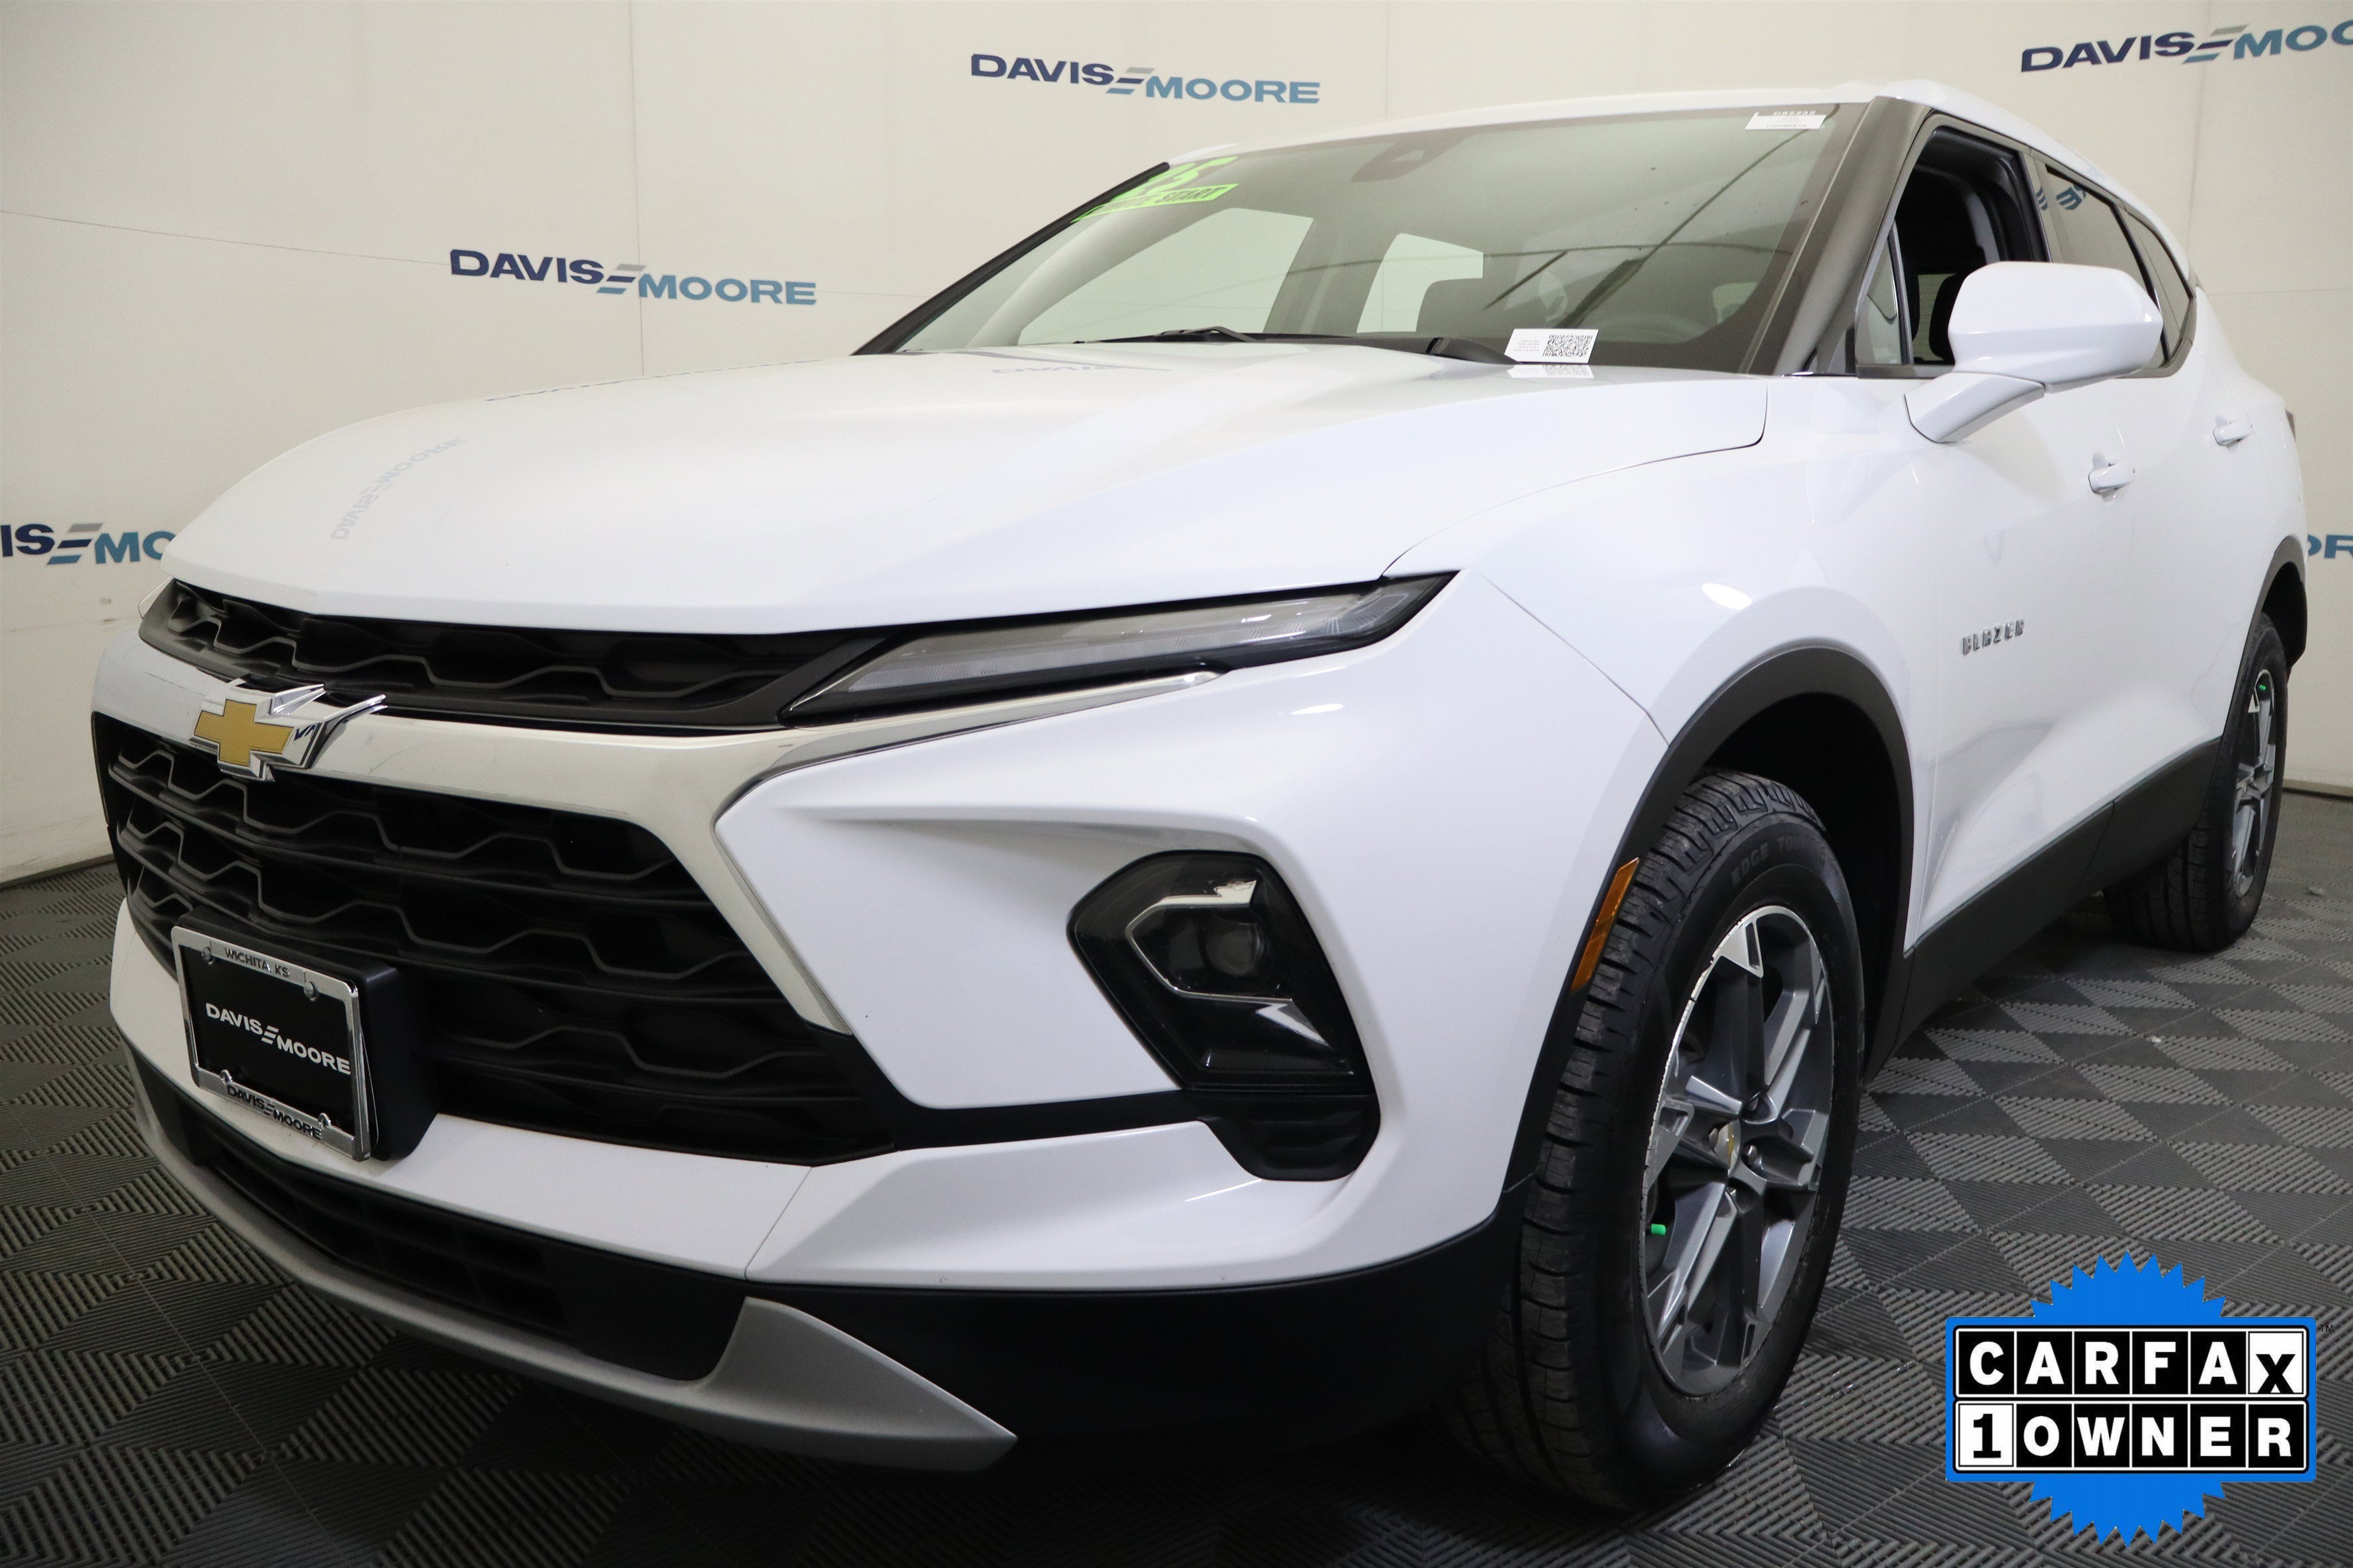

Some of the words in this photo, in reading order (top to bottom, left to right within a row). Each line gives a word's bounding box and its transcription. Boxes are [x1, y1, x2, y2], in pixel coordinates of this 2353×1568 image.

[2022, 31, 2195, 72] DAVIS
[971, 53, 1114, 86] DAVIS
[1145, 76, 1321, 105] MOORE
[451, 249, 605, 285] DAVIS
[638, 273, 817, 306] MOORE
[1962, 619, 2025, 655] BLAZER
[275, 964, 290, 977] KS
[206, 1003, 263, 1035] DAVIS
[276, 1035, 352, 1075] MOORE
[227, 1085, 265, 1109] DAVIS
[273, 1109, 323, 1140] MOORE
